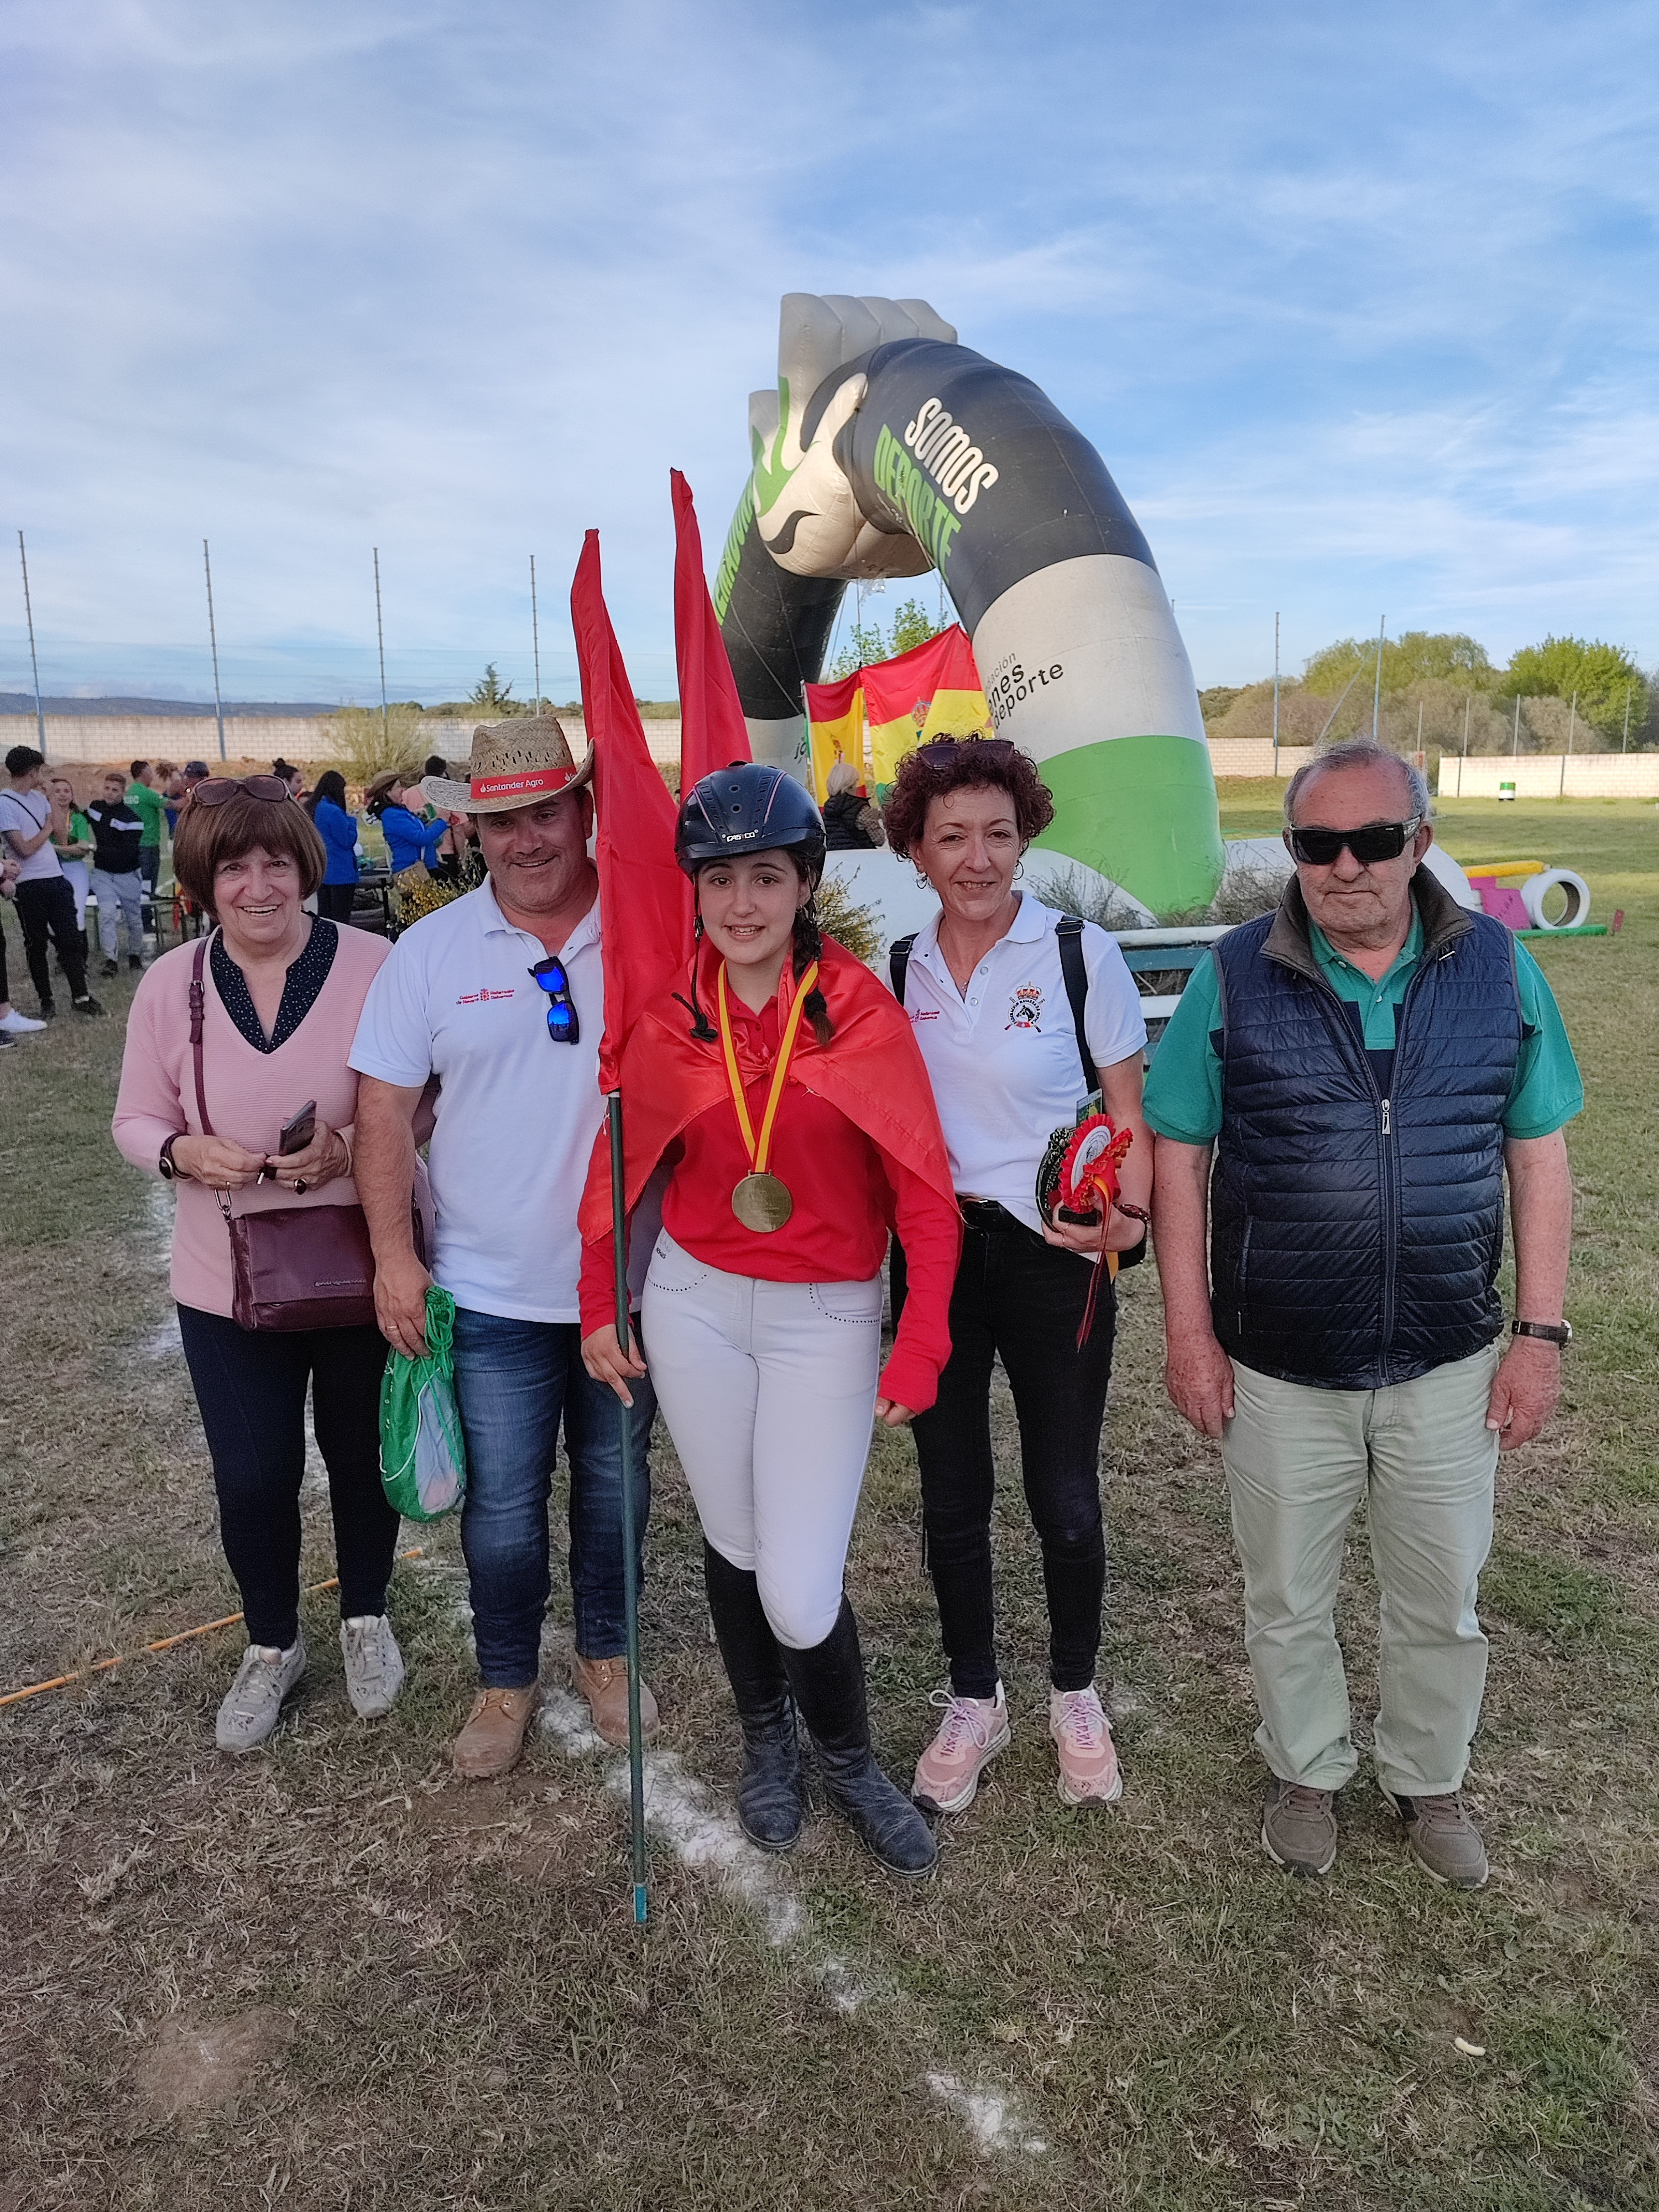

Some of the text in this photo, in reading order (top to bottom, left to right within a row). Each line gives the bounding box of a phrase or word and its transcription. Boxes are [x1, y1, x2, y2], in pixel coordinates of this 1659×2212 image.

[904, 397, 999, 514] SOMOS
[874, 423, 962, 585] DEPORTE
[994, 664, 1063, 729] deporte
[486, 779, 544, 792] Santander Agro
